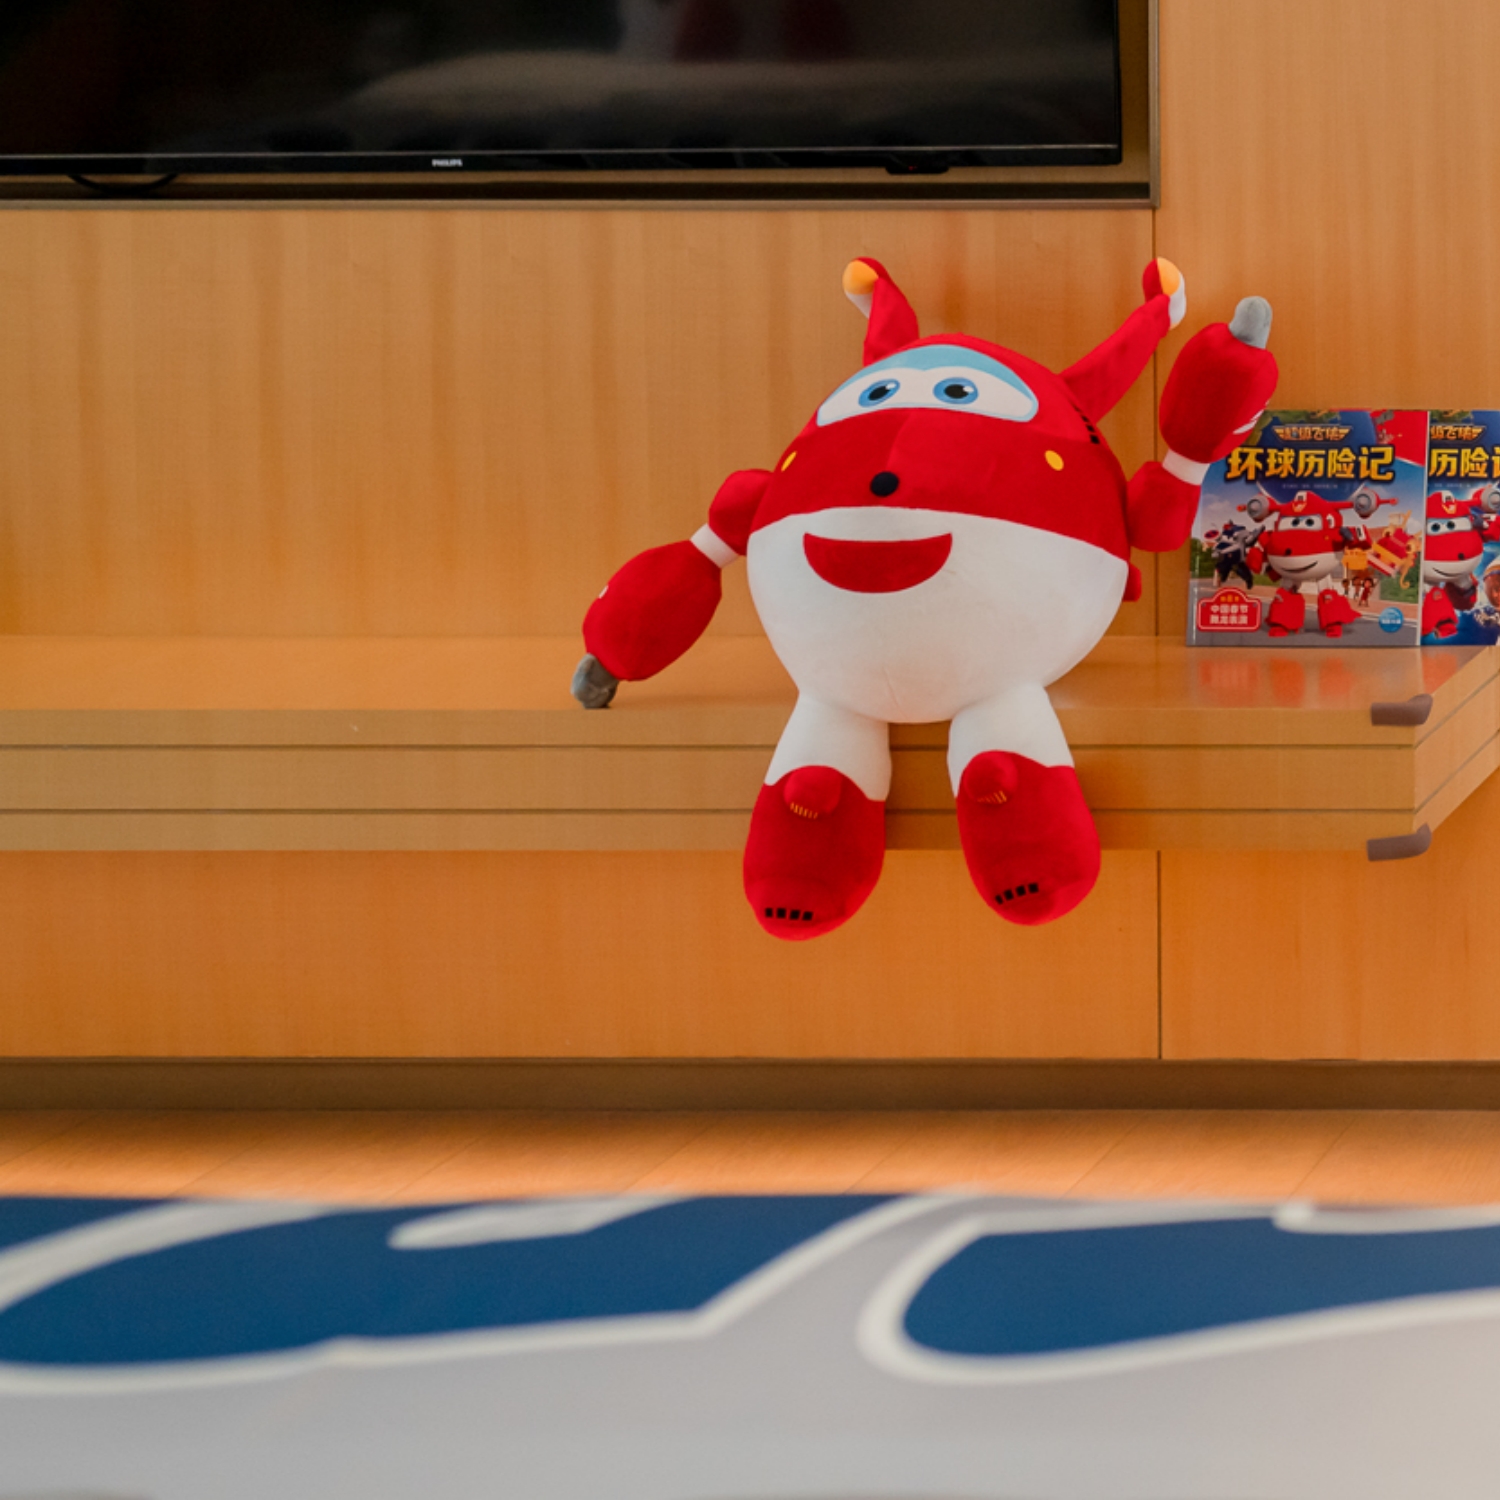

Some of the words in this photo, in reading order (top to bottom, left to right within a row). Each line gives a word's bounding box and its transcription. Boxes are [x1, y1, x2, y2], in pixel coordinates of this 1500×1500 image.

[1226, 446, 1395, 481] 环球历险记
